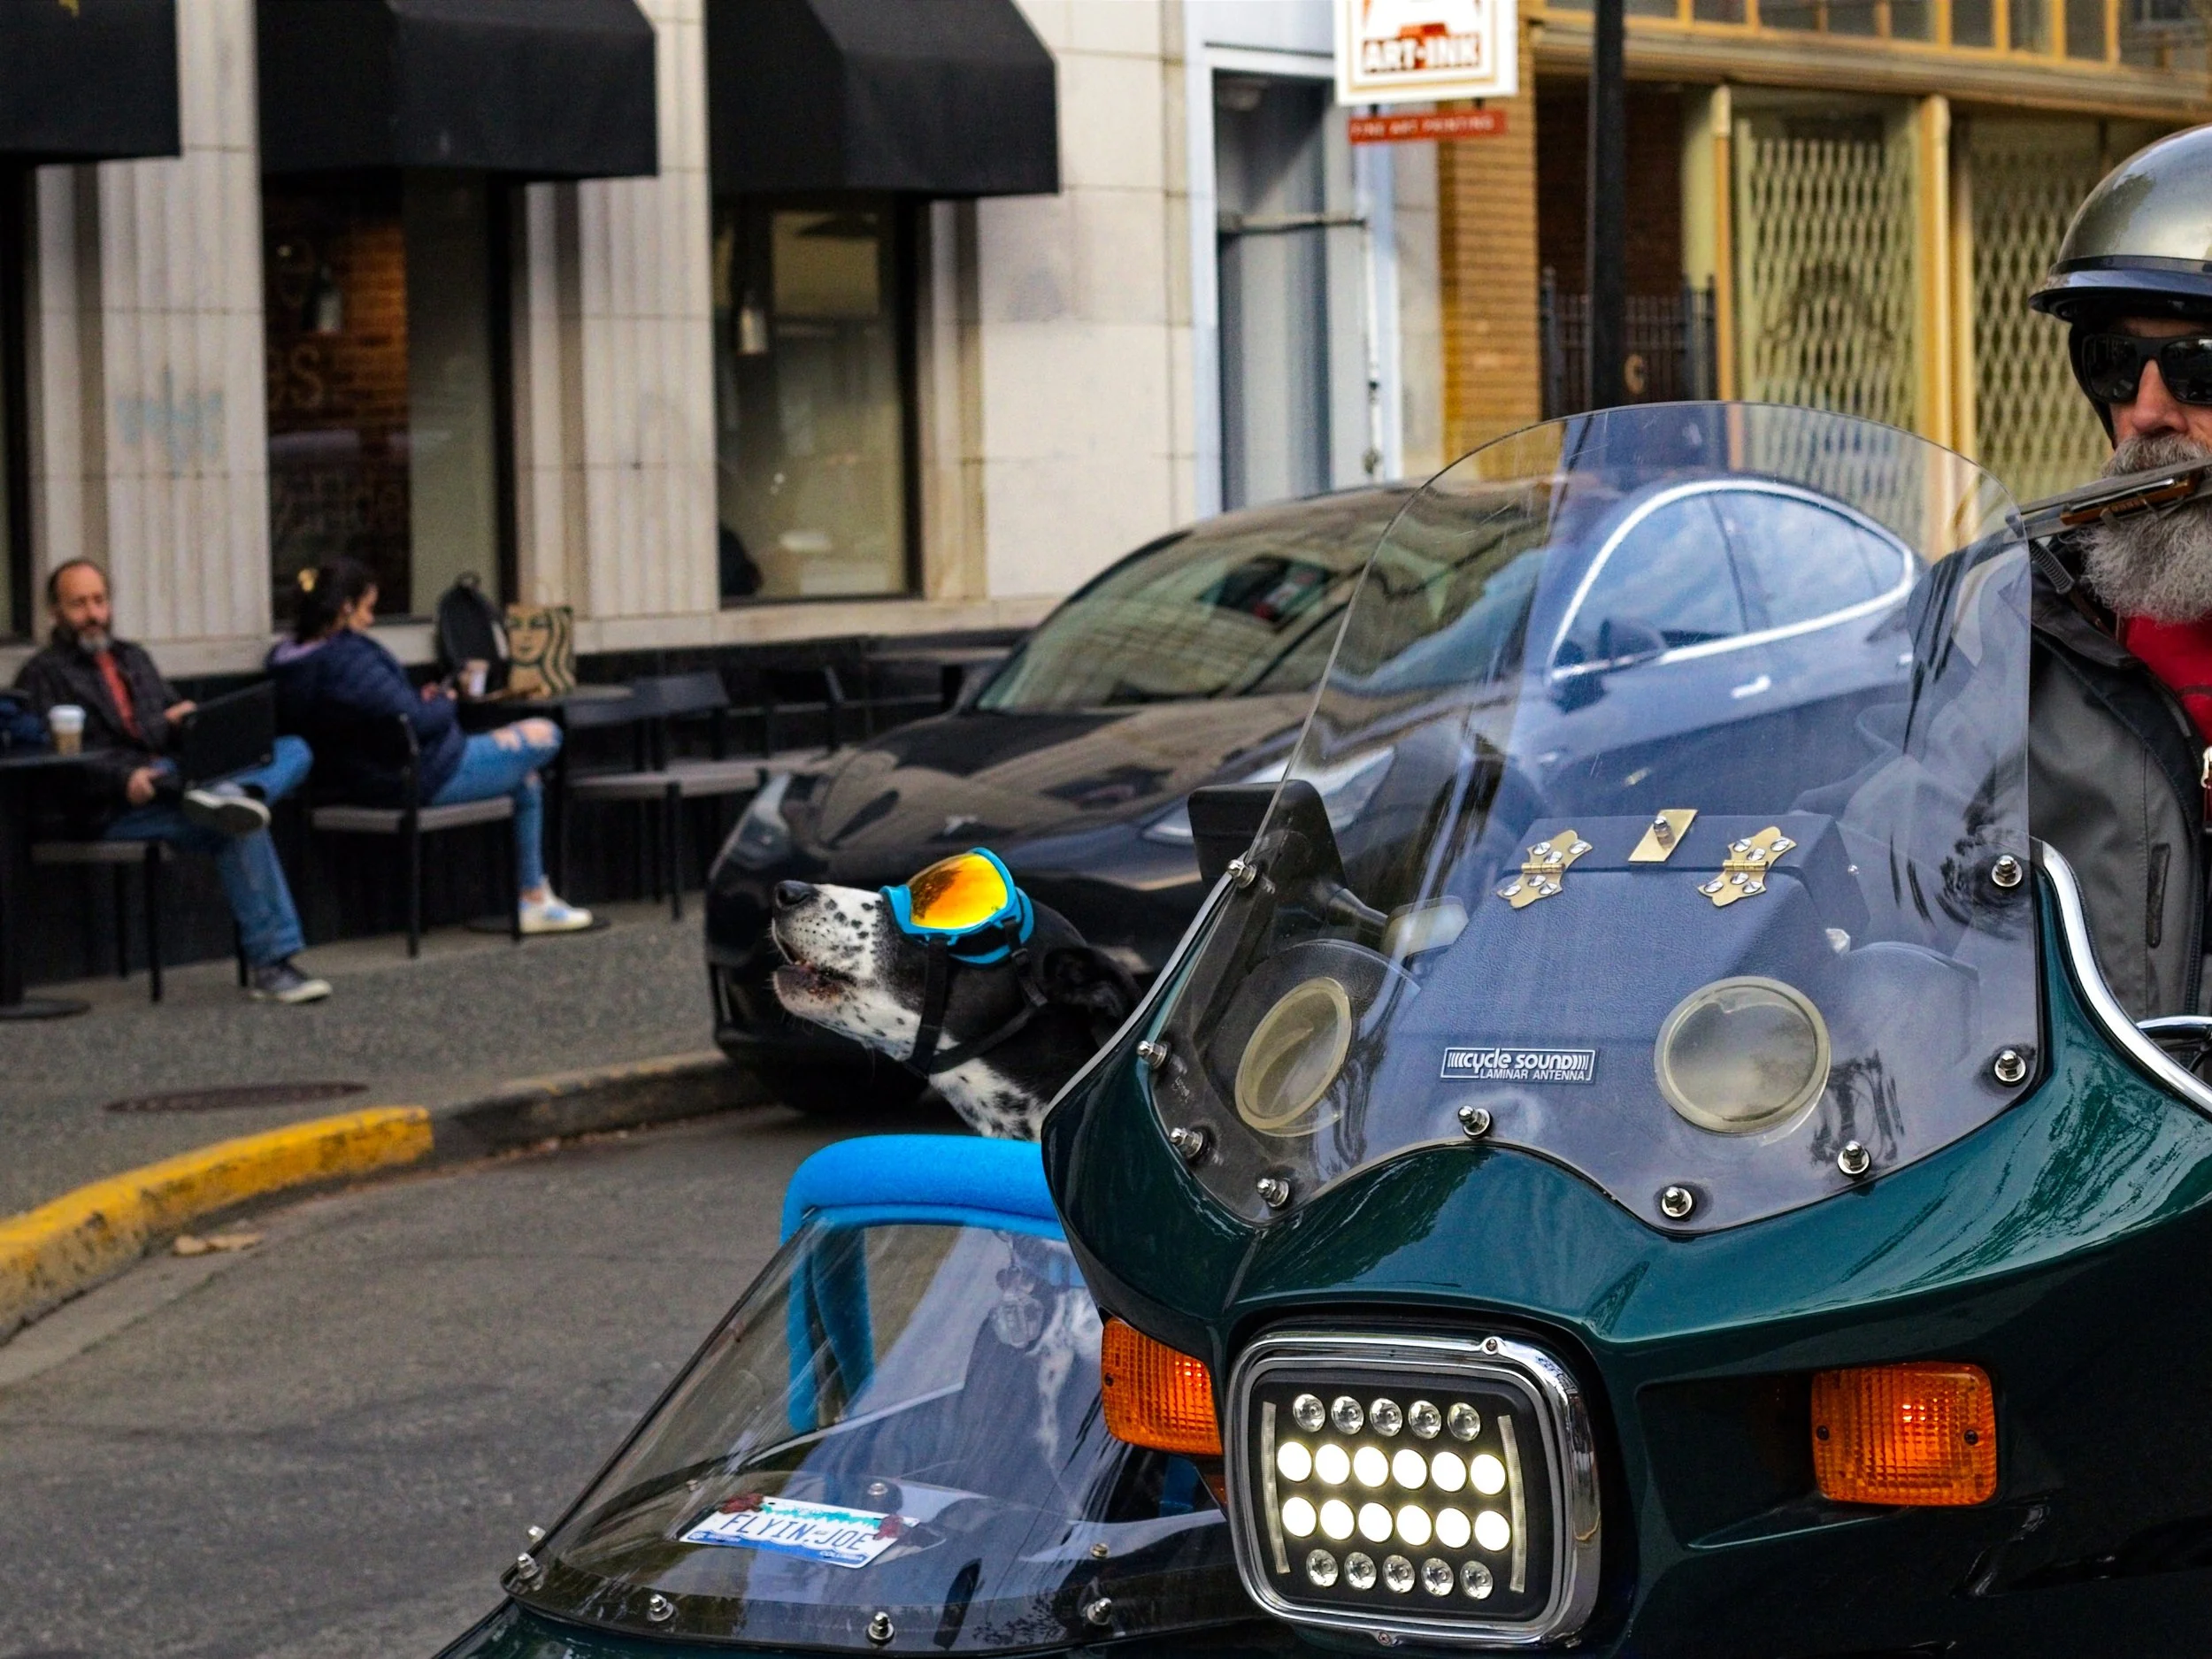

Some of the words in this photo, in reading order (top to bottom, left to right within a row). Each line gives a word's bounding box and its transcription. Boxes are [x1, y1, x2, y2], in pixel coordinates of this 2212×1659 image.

[1389, 119, 1418, 134] ART
[1479, 1069, 1528, 1079] LAMINAR
[1532, 1070, 1585, 1080] ANTENNA
[814, 1530, 873, 1551] JOE
